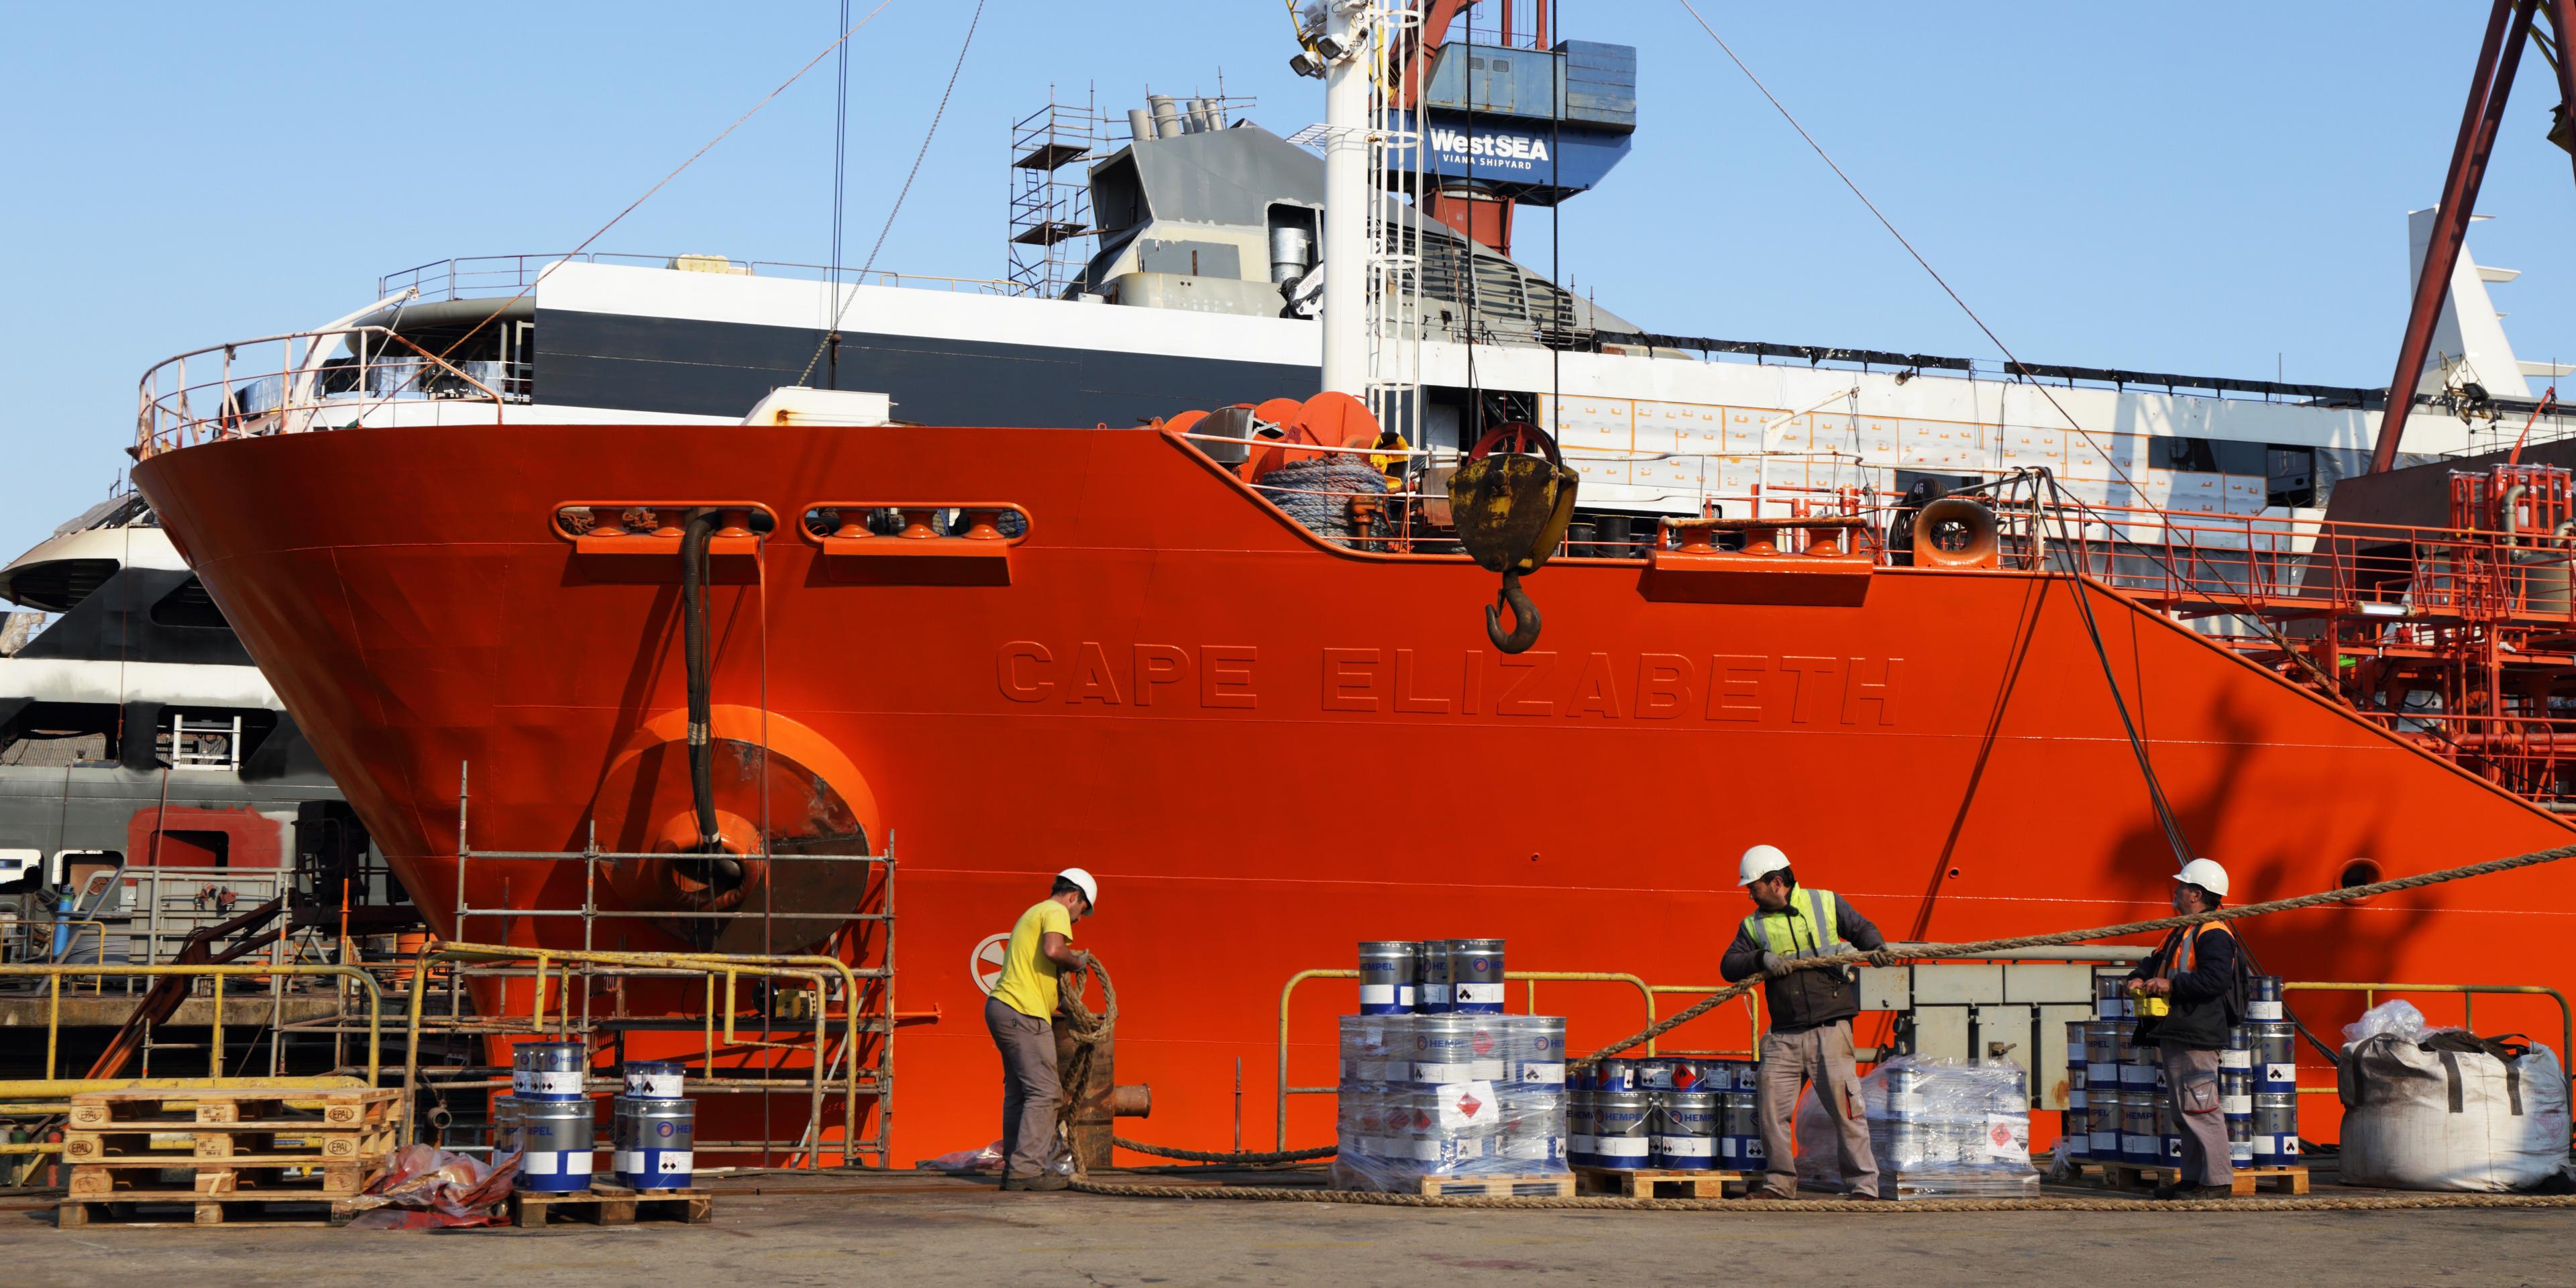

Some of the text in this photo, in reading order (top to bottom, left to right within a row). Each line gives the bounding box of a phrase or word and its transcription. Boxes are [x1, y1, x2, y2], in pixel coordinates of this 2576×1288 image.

[1430, 127, 1549, 161] WestSEA
[1443, 154, 1532, 170] VIANA SHIPYARD
[1301, 272, 1320, 291] FASSI
[1914, 483, 1924, 494] 46
[997, 641, 1904, 727] CAPE ELIZABETH
[332, 1110, 350, 1119] EPAL
[71, 1143, 89, 1153] EPAL
[331, 1142, 348, 1152] EPAL
